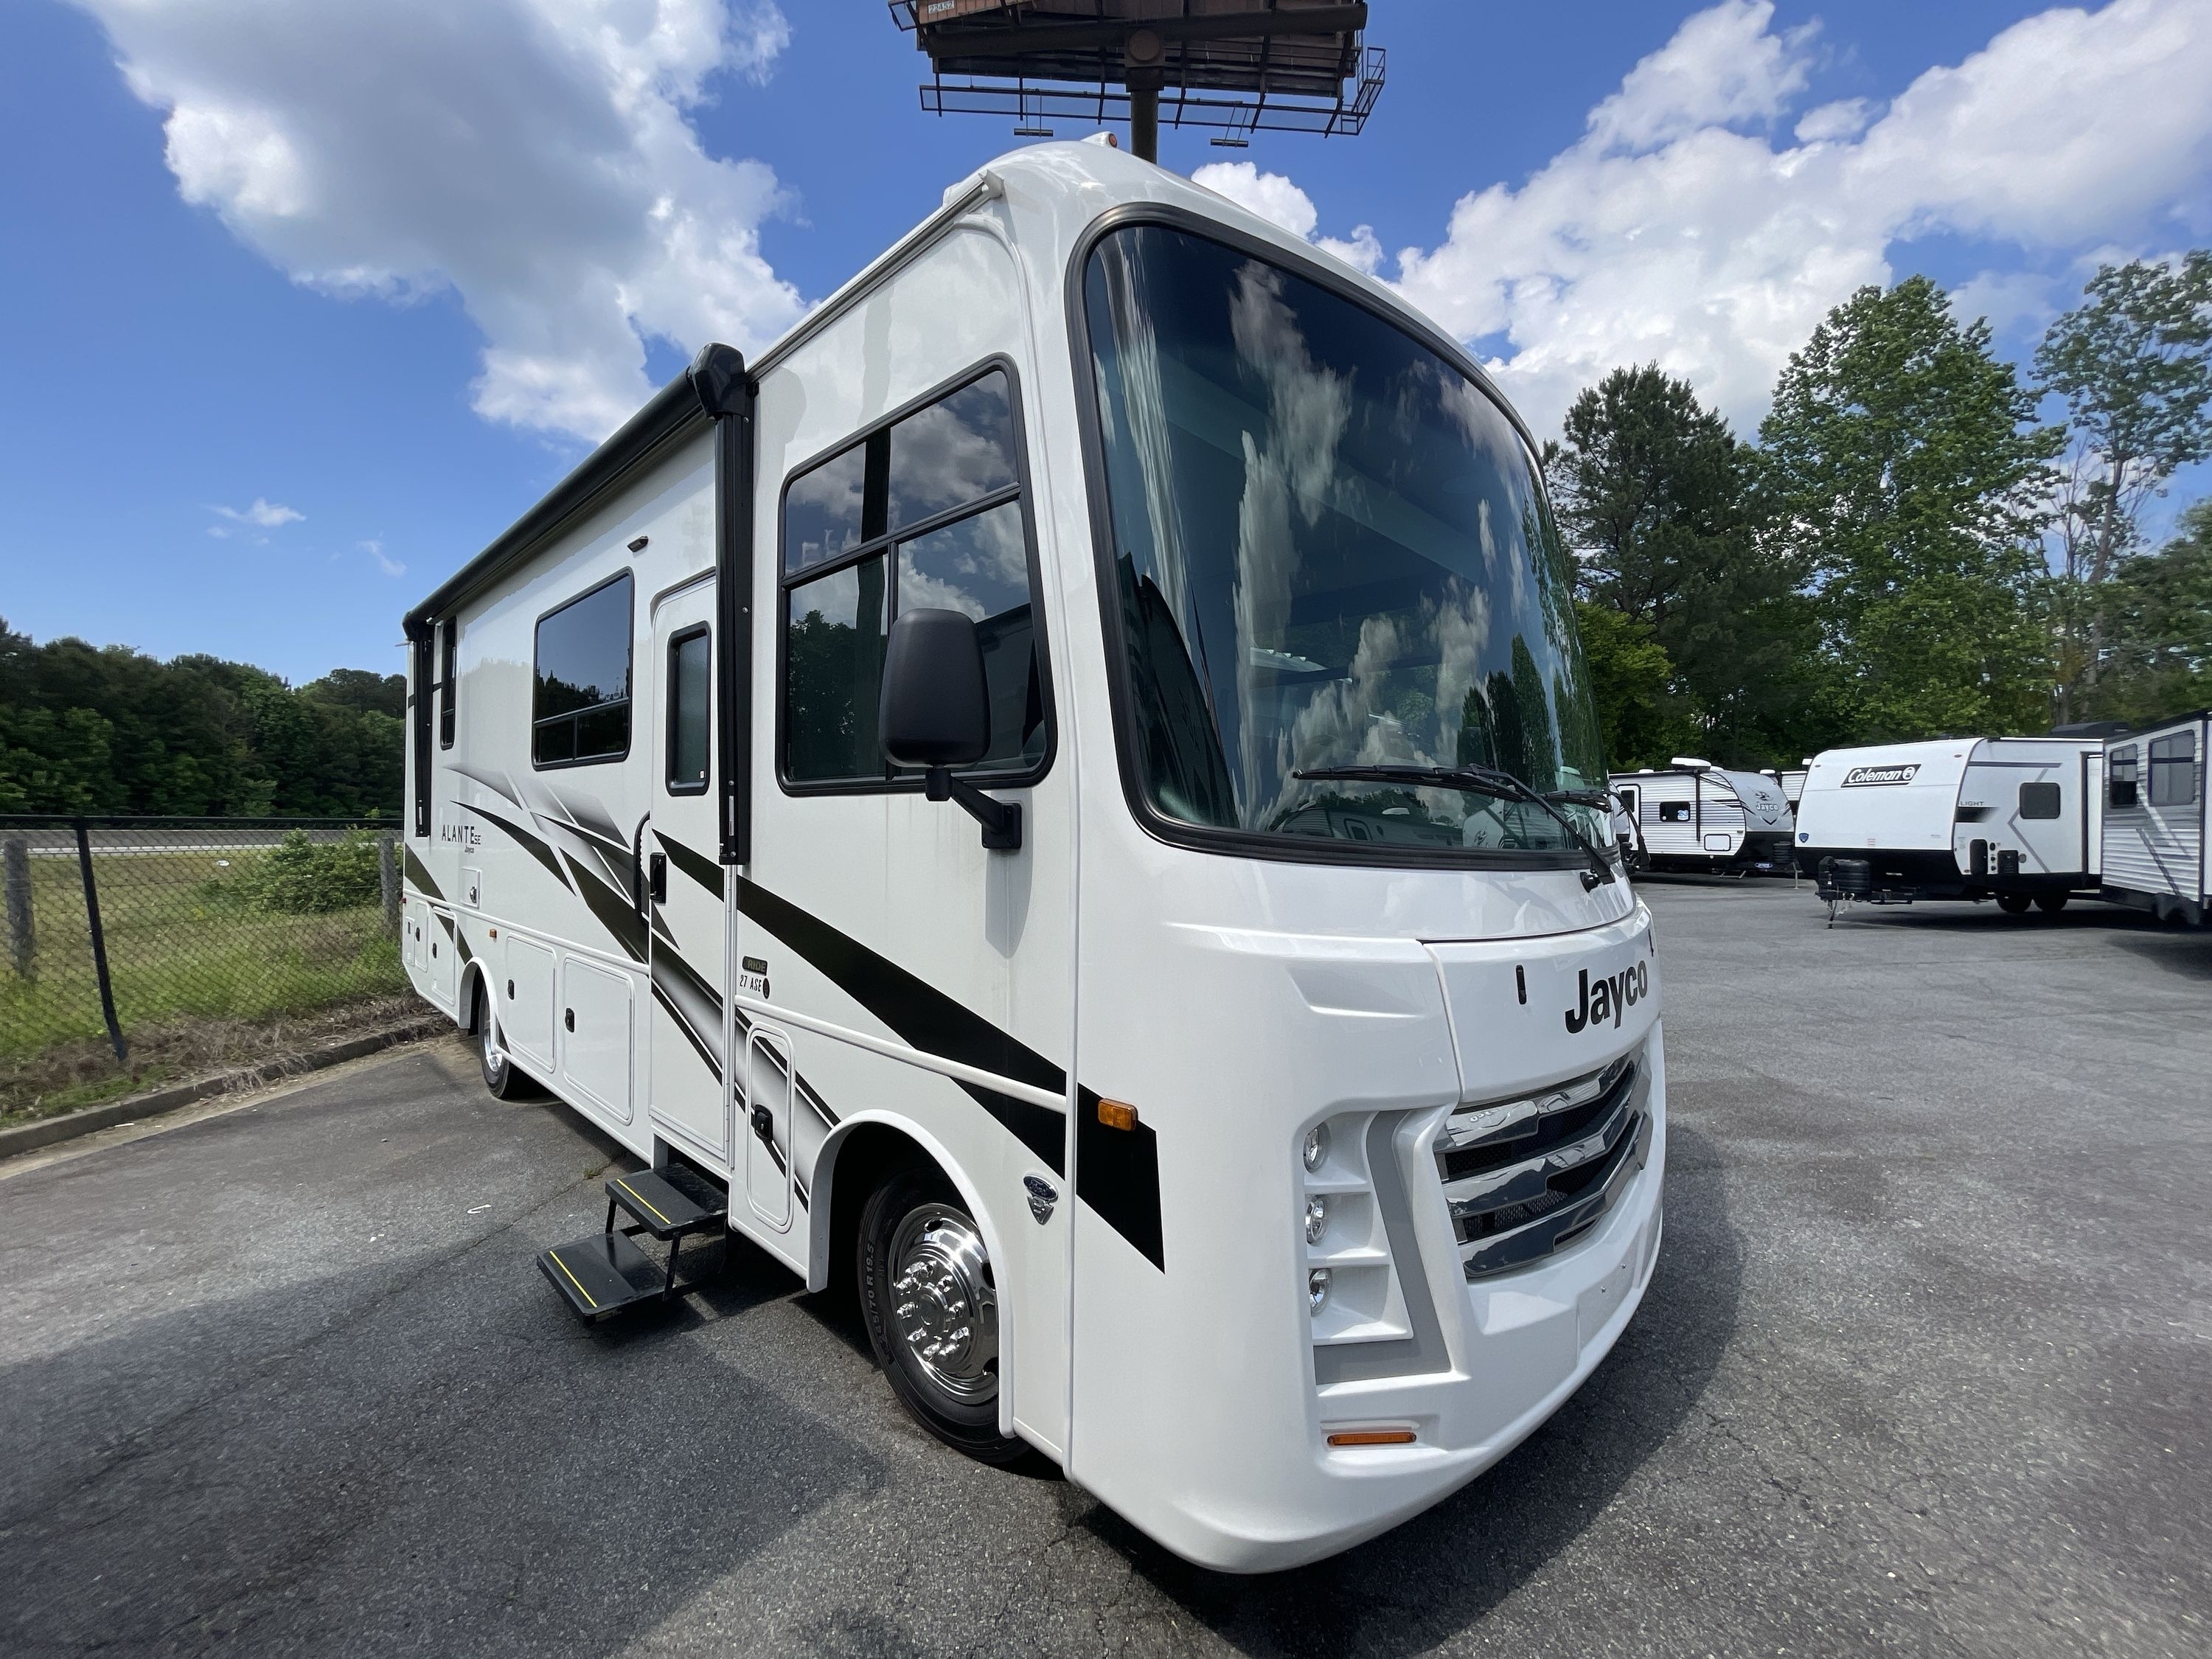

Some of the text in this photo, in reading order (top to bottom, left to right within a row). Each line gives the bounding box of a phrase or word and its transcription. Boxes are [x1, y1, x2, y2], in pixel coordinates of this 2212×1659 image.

[1848, 768, 1902, 783] Coleman
[1756, 801, 1778, 813] Jayco
[442, 824, 474, 844] ALANTE
[740, 974, 762, 992] 27 ASE
[1565, 960, 1648, 1034] Jayco
